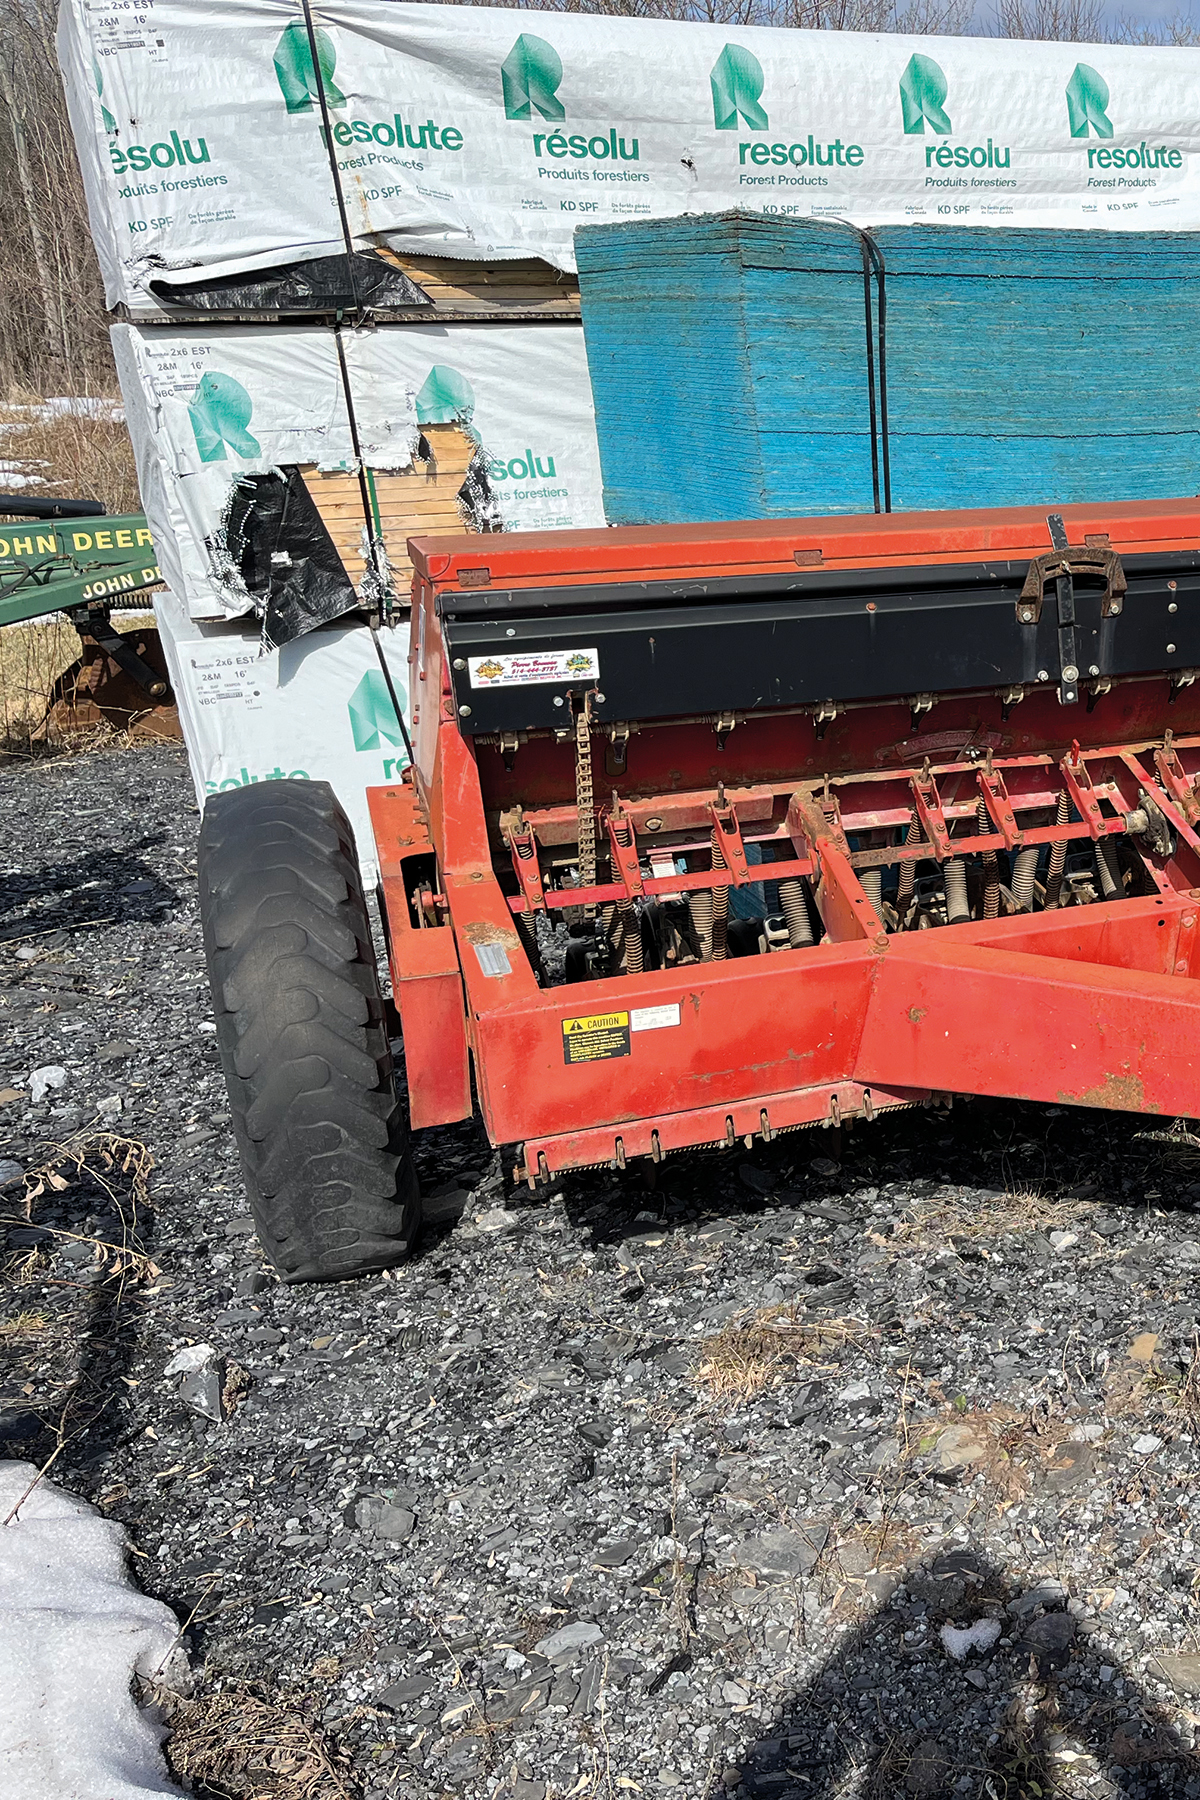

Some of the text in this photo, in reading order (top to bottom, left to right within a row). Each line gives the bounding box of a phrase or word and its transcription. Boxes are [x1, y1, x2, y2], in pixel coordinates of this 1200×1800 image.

[111, 1, 130, 10] 2x6
[134, 0, 155, 9] EST
[98, 17, 120, 27] 2&M
[532, 128, 640, 160] résolu
[738, 134, 865, 167] resolute
[109, 130, 211, 174] ésolu
[925, 138, 1011, 168] résolu
[1087, 141, 1183, 169] resolute
[329, 152, 424, 171] orest Products
[537, 167, 650, 182] Produits forestiers
[739, 174, 829, 186] Forest Products
[160, 174, 228, 192] forestiers
[925, 176, 1017, 188] Produits forestiers
[1087, 177, 1157, 188] Forest Products
[363, 189, 380, 201] KD
[382, 184, 403, 198] SPF
[560, 200, 599, 212] KD SPF
[763, 205, 800, 215] KD SPF
[938, 205, 970, 215] KD SPF
[1107, 203, 1121, 211] KD
[1122, 202, 1139, 210] SPF
[128, 216, 174, 233] KD SPF
[170, 347, 188, 356] 2x6
[191, 346, 212, 355] EST
[157, 362, 178, 371] 2&M
[490, 448, 557, 481] solu
[513, 487, 569, 501] forestiers
[72, 528, 153, 551] DEER
[82, 573, 135, 599] JOHN
[216, 658, 232, 667] 2x6
[236, 655, 255, 665] EST
[202, 672, 221, 681] 2&M
[587, 1017, 619, 1028] CAUTION
